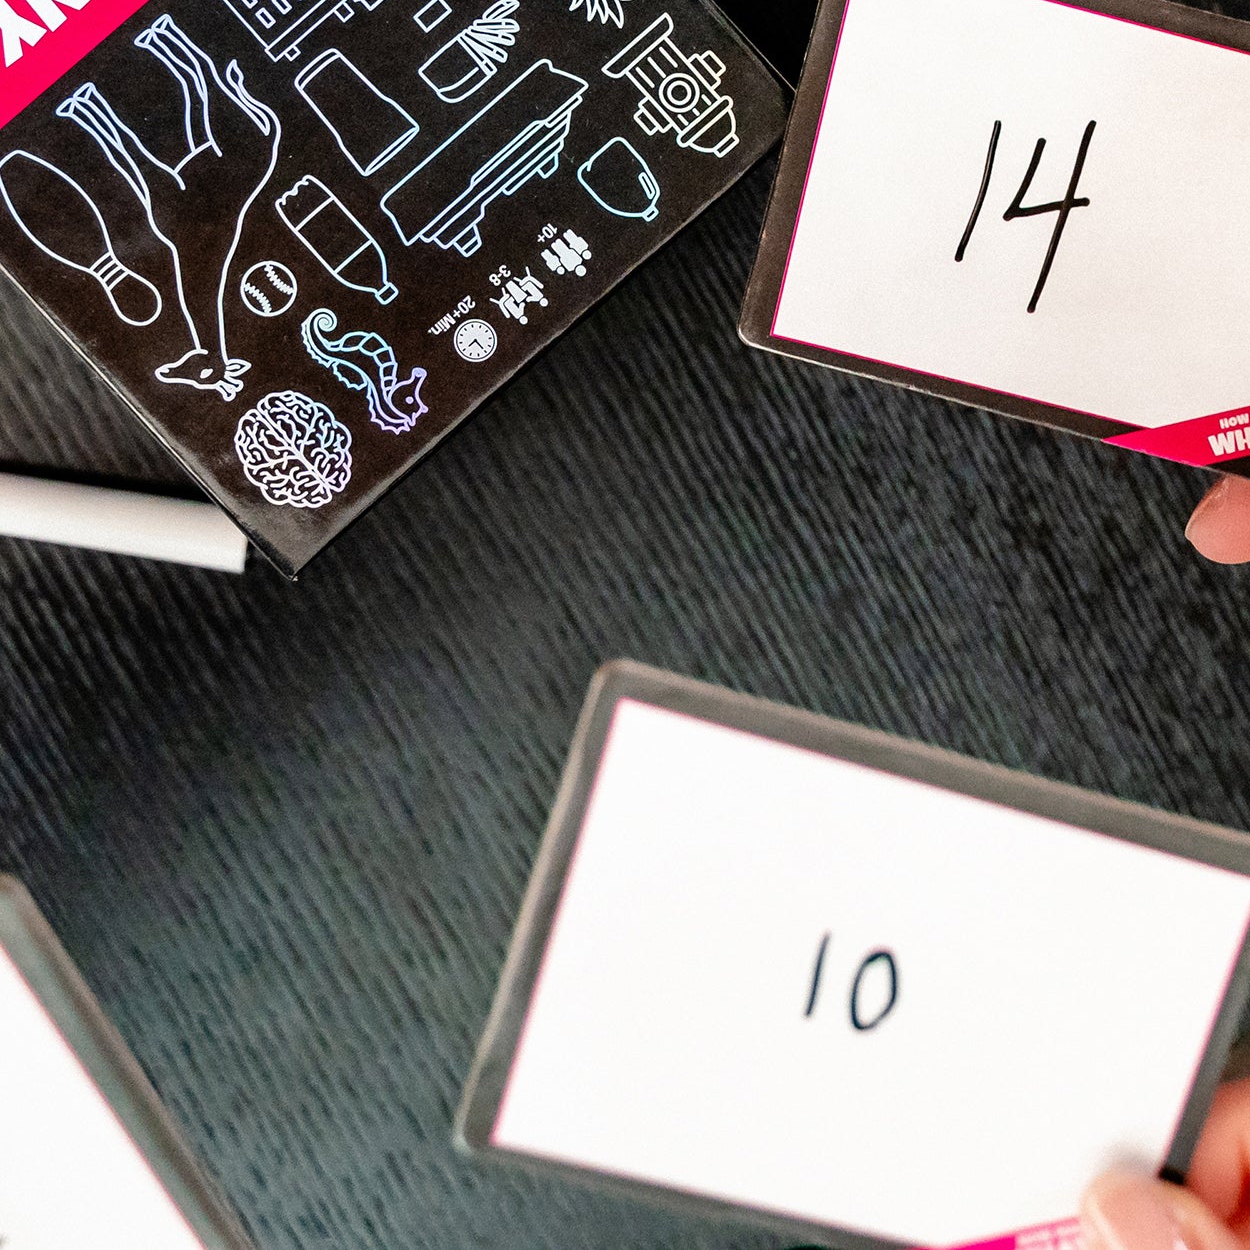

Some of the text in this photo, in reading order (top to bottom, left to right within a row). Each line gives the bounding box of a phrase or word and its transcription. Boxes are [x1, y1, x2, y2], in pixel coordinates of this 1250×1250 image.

[954, 120, 1097, 313] 14
[537, 223, 558, 243] 10+
[489, 265, 511, 286] 3-8
[1219, 413, 1249, 429] HOW
[804, 930, 897, 1031] 10
